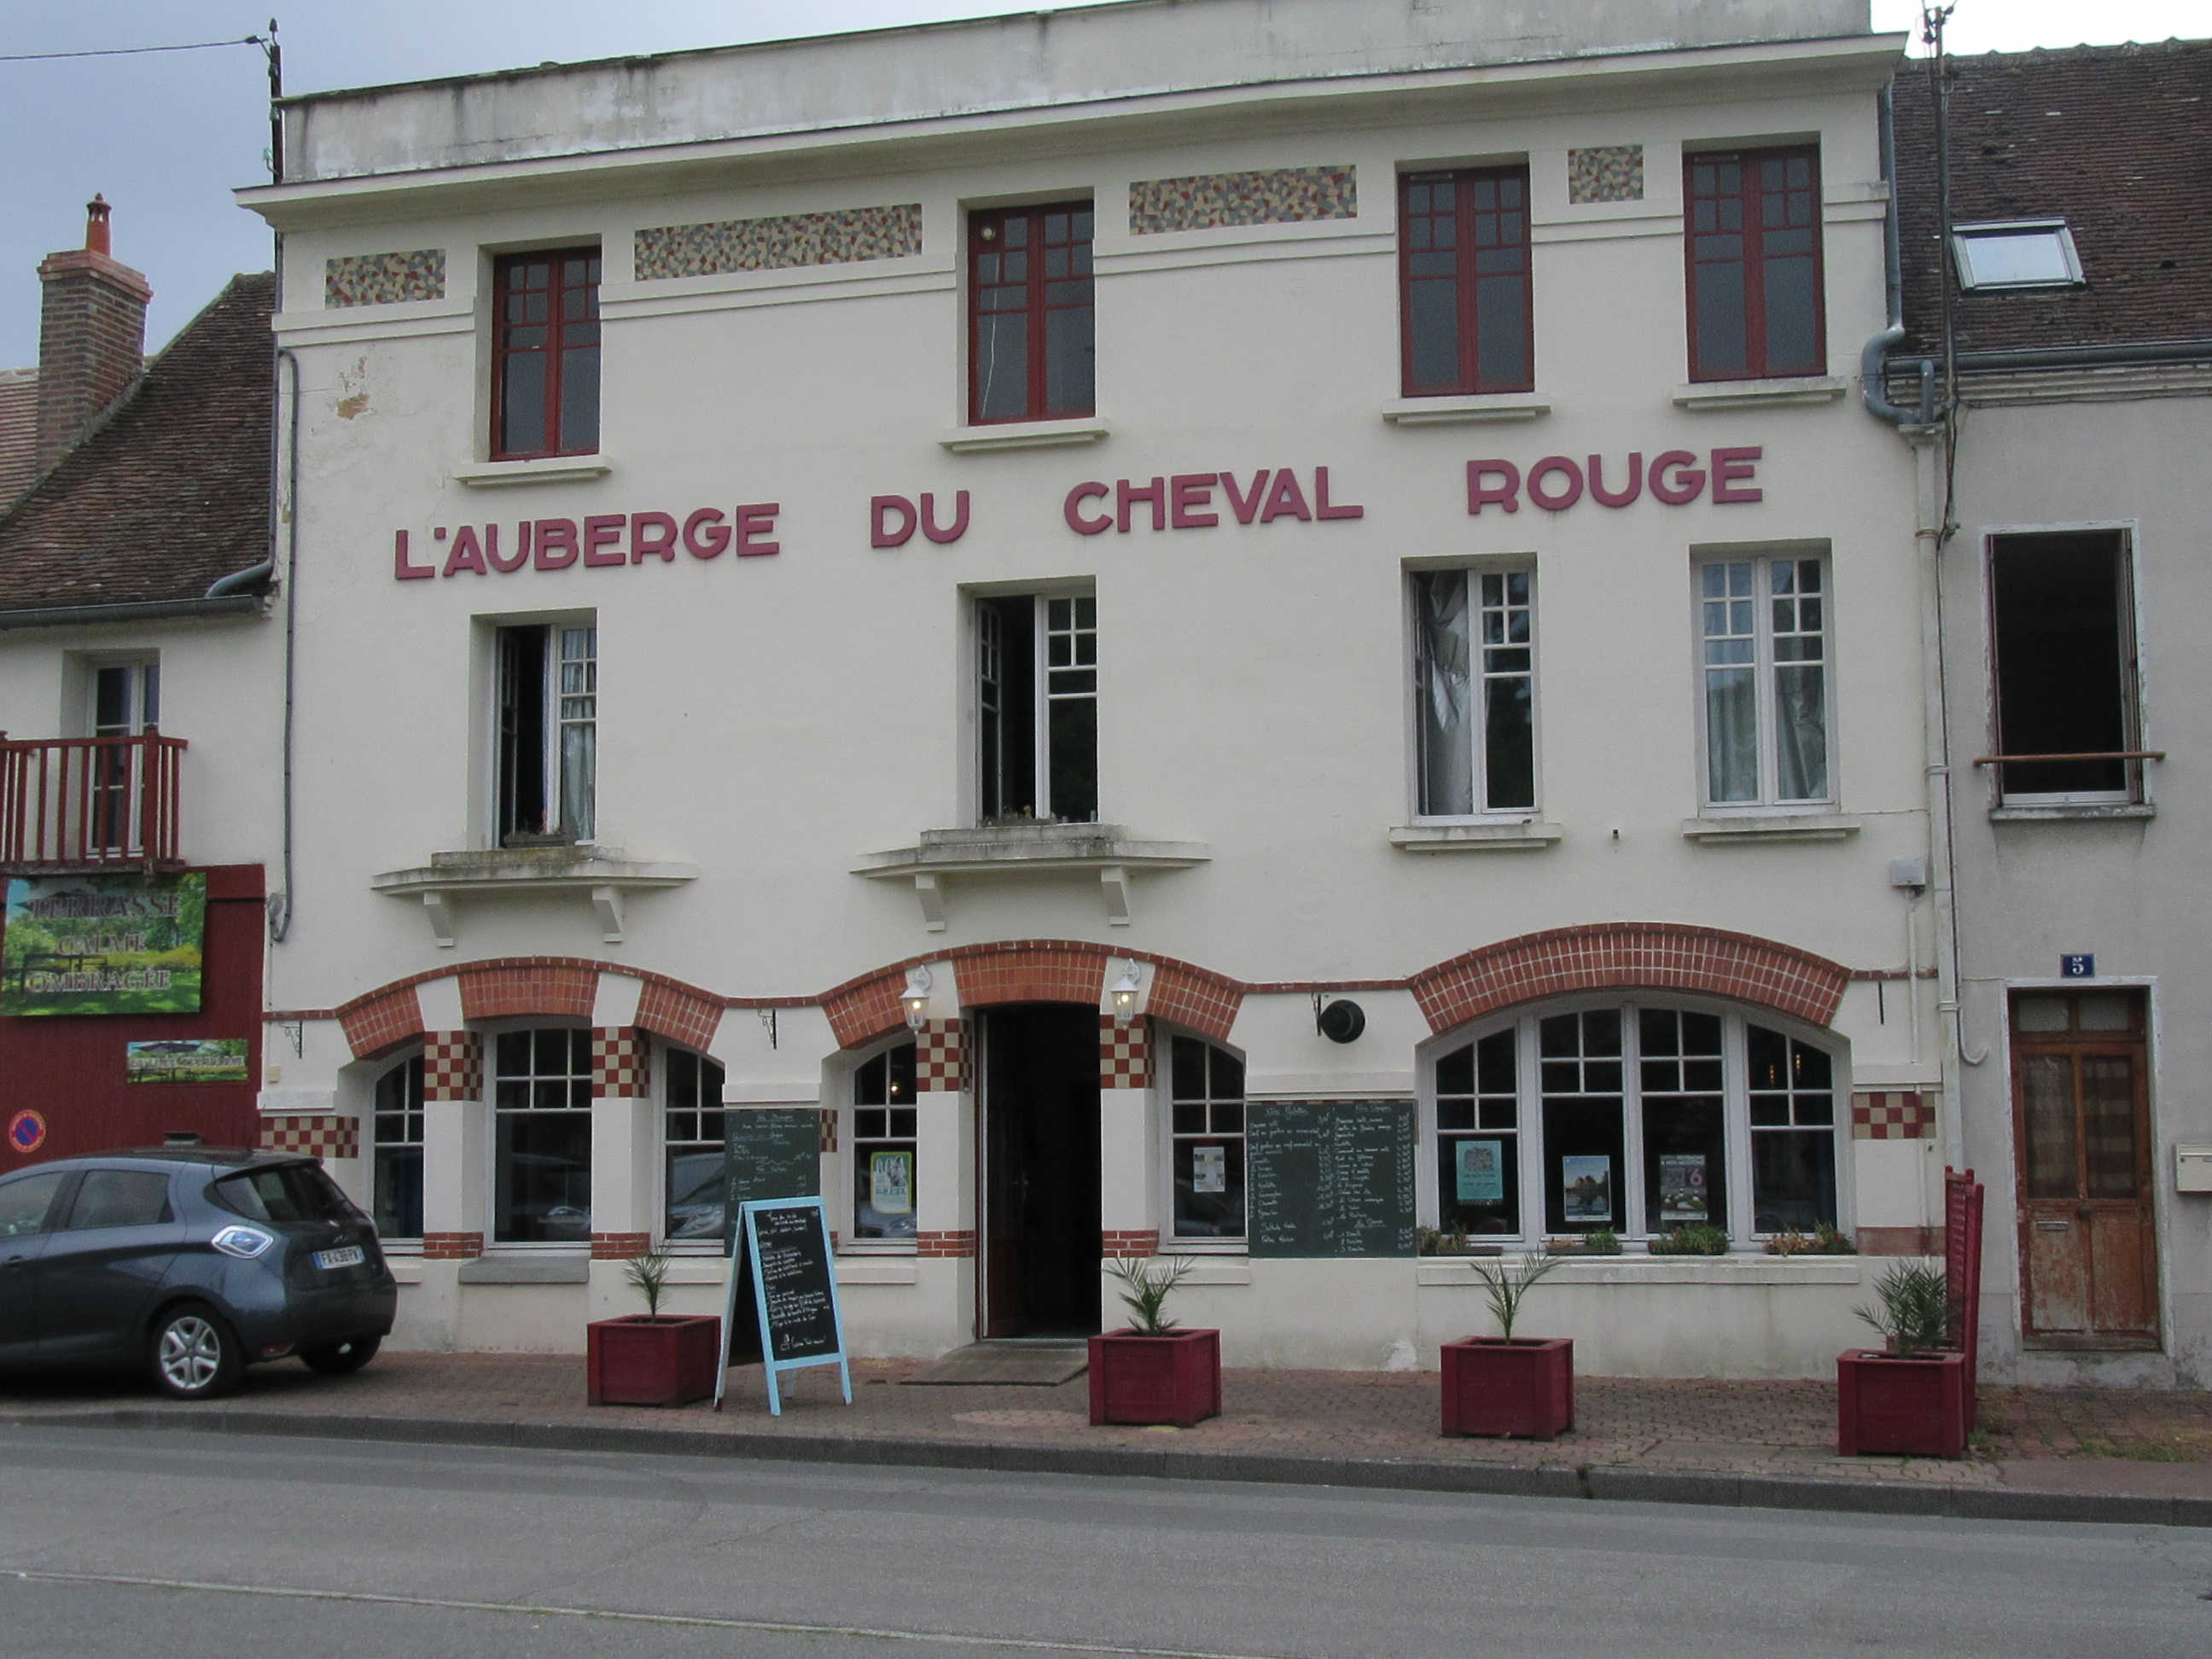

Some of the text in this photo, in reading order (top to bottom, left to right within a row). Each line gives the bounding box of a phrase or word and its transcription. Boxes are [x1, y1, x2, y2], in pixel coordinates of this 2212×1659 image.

[394, 446, 1762, 579] L'AUBERGE DU CHEVAL ROUGE
[28, 893, 183, 920] TERRASSE
[57, 933, 148, 955] CALME
[28, 965, 172, 993] OMBRAGÉE
[2072, 957, 2084, 975] 5
